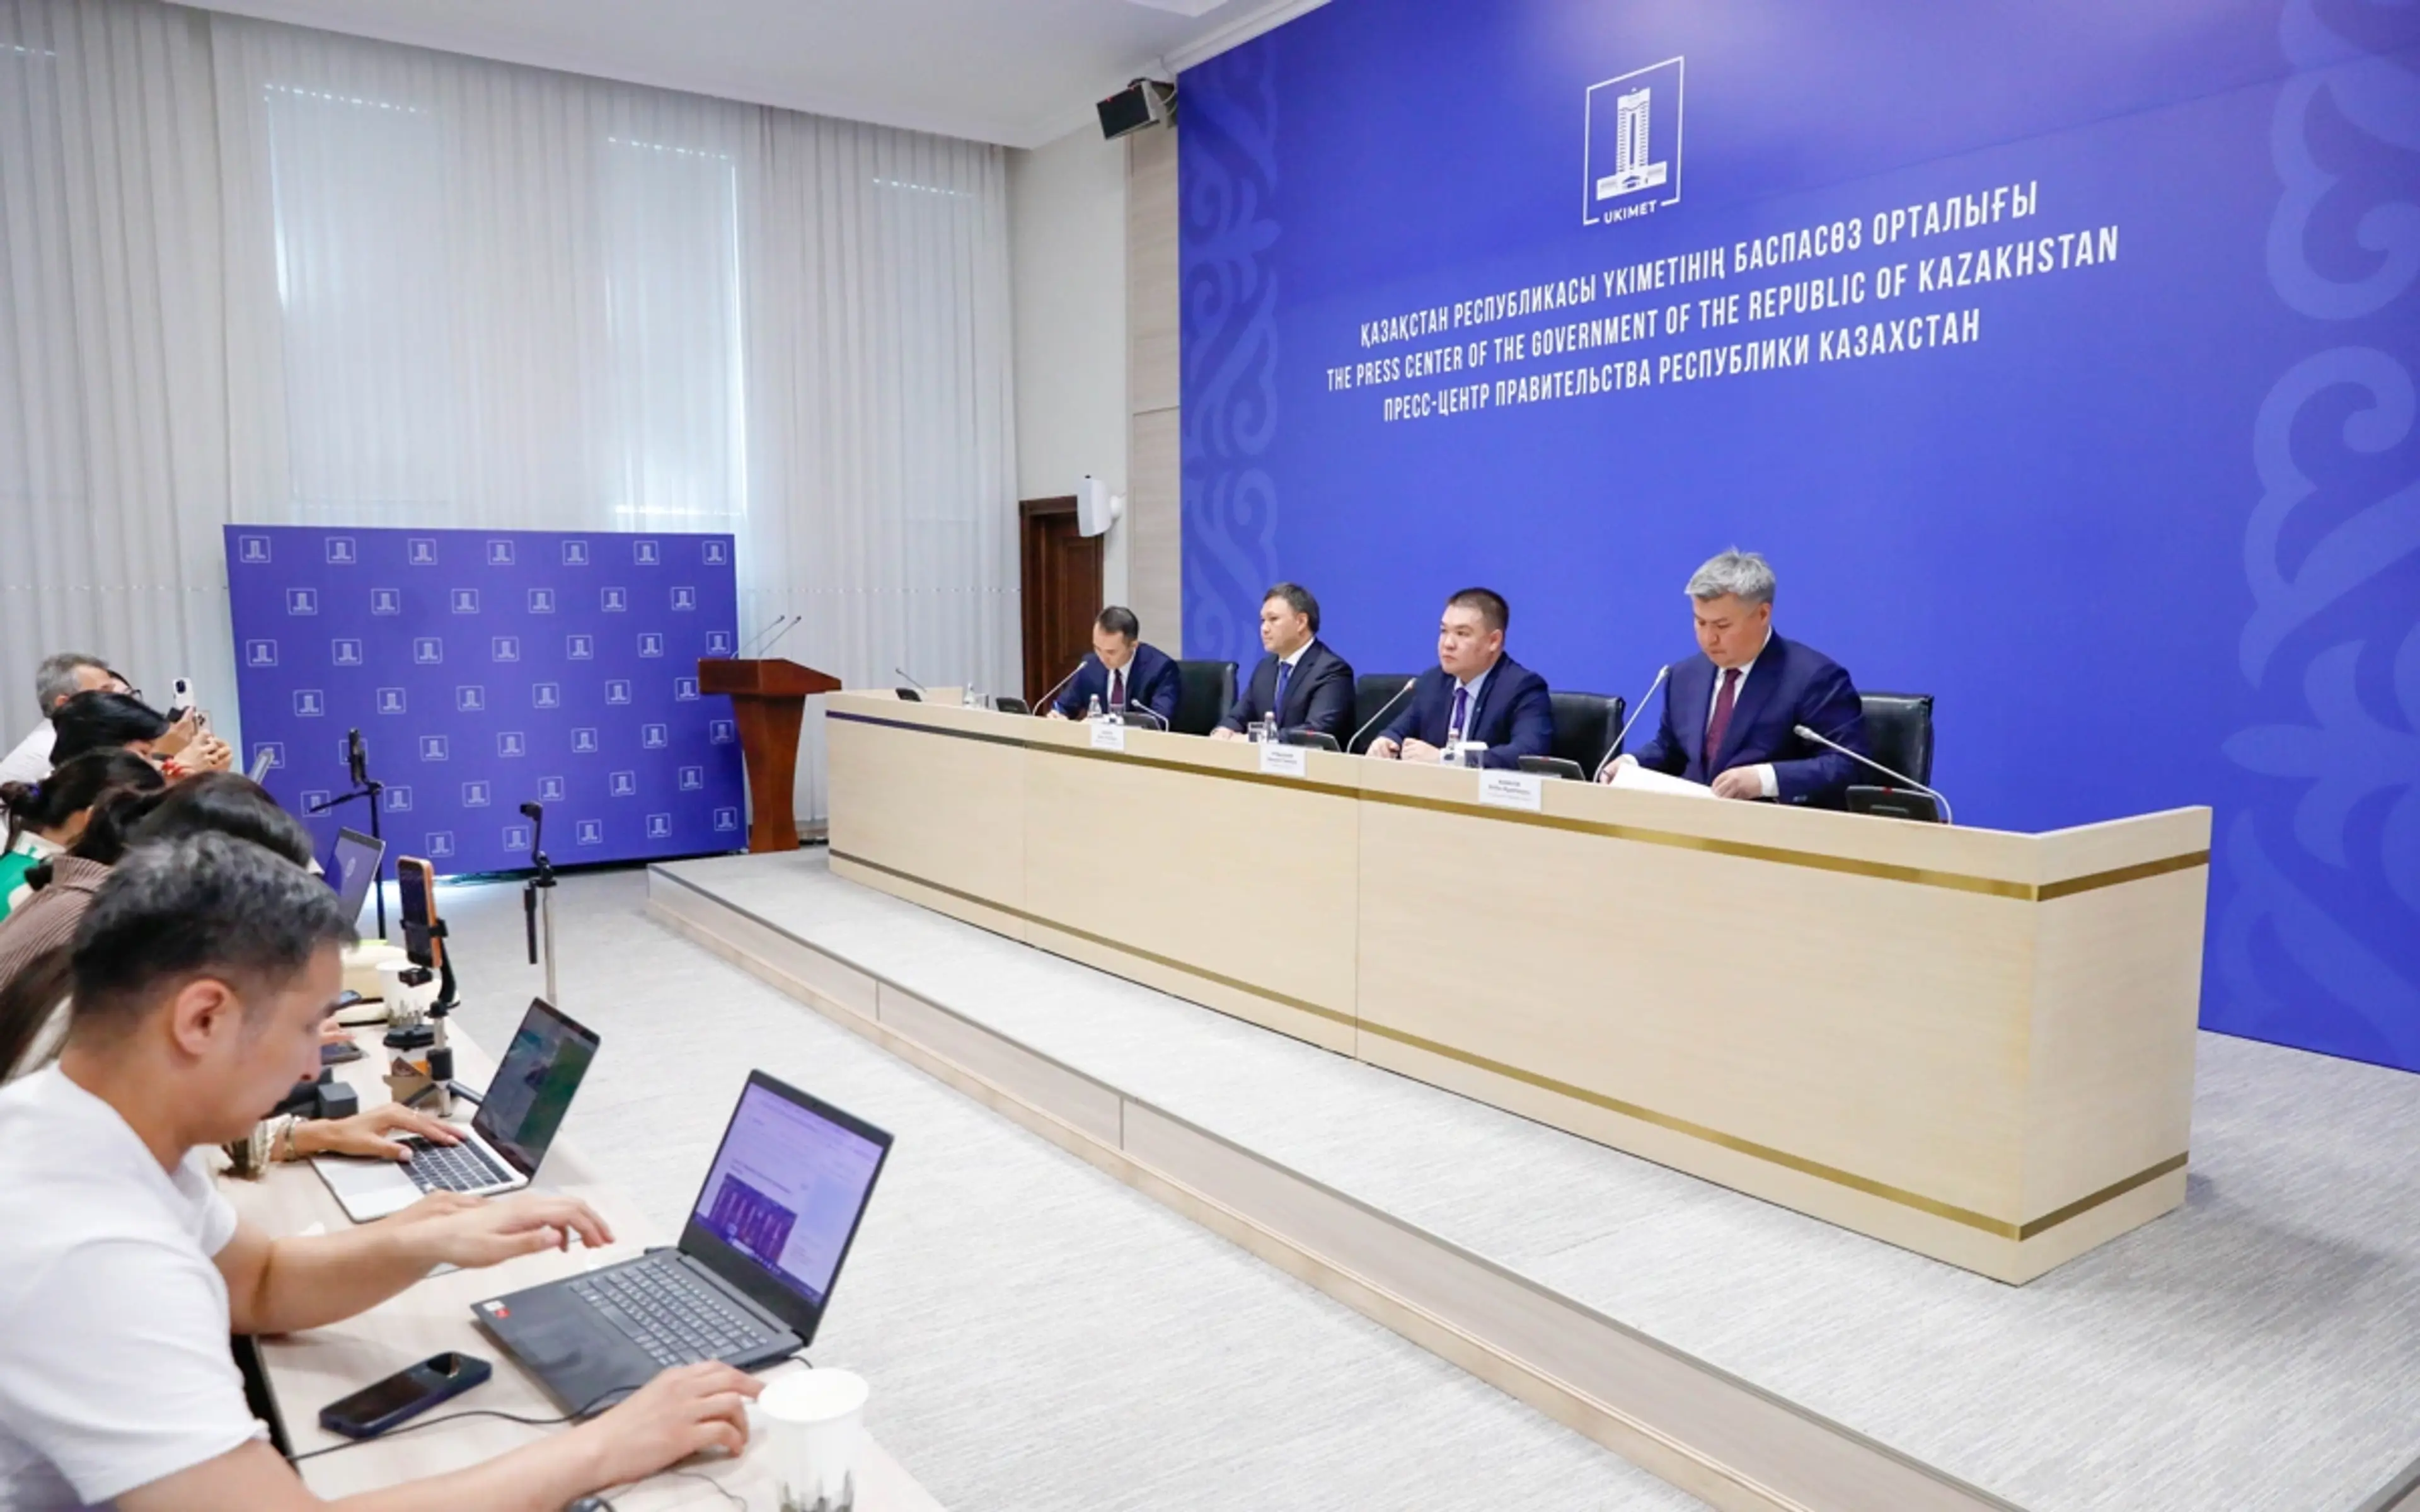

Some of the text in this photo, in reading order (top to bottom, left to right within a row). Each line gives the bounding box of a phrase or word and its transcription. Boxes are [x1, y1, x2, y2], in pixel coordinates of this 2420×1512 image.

[1361, 181, 2037, 348] ҚАЗАҚСТАН РЕСПУБЛИКАСЫ ҮКІМЕТІНІҢ БАСПАСӨЗ ОРТАЛЫҒЫ
[1604, 200, 1657, 224] UKIMET
[1327, 226, 2118, 391] THE PRESS CENTER OF THE GOVERNMENT OF THE REPUBLIC OF KAZAKHSTAN
[1384, 308, 1979, 421] ПРЕСС-ЦЕНТР ПРАВИТЕЛЬСТВА РЕСПУБЛИКИ КАЗАХСТАН
